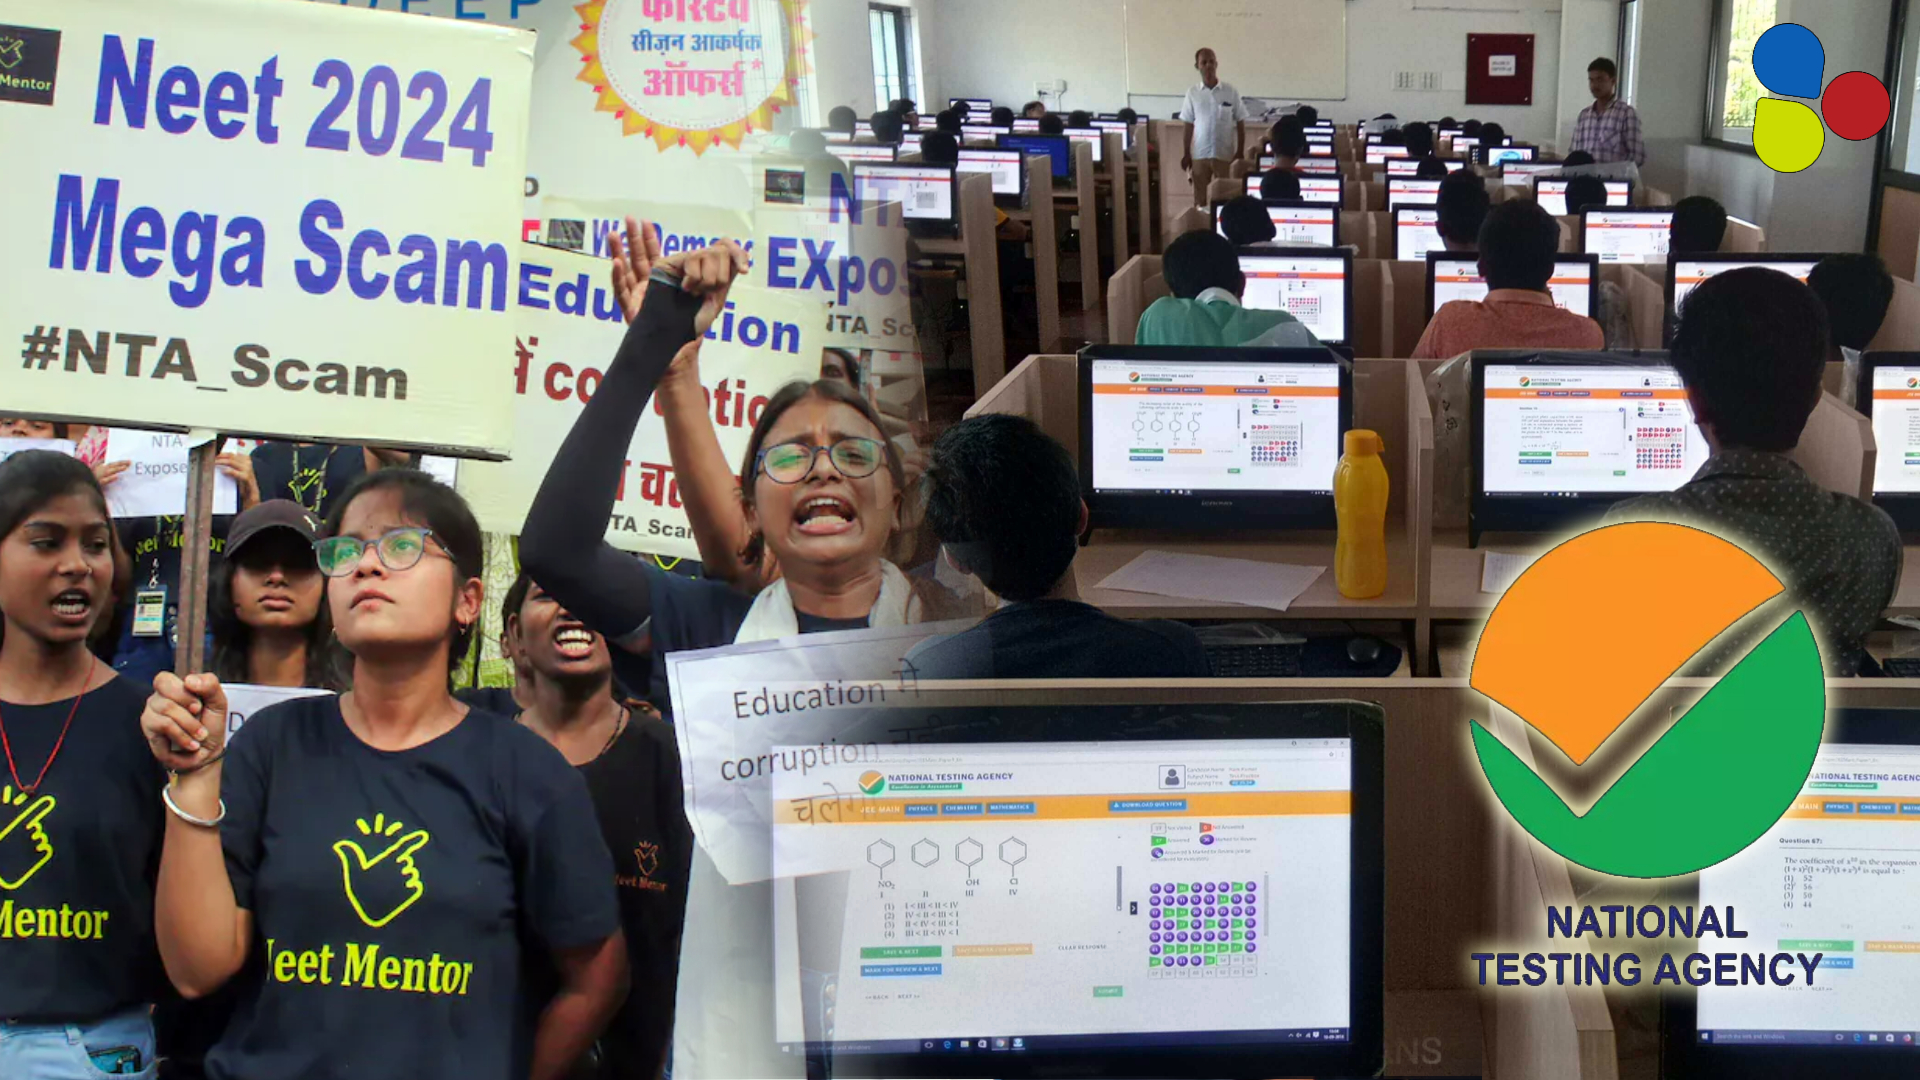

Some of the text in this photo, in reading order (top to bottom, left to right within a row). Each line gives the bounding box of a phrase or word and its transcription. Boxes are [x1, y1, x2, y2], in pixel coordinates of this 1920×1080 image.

[0, 73, 52, 91] Mentor
[94, 34, 494, 167] Neet 2024
[829, 172, 907, 227] NT
[49, 173, 509, 312] Mega Scam
[21, 325, 408, 400] #NTA_Scam
[152, 435, 183, 448] NTA
[733, 680, 885, 718] Education
[720, 738, 878, 781] corruption
[888, 772, 1014, 782] NATIONAL TESTING AGENCY
[1854, 773, 1889, 781] TESTING
[1800, 857, 1835, 865] coefficient
[0, 899, 109, 940] Mentor
[341, 943, 473, 995] Mentor
